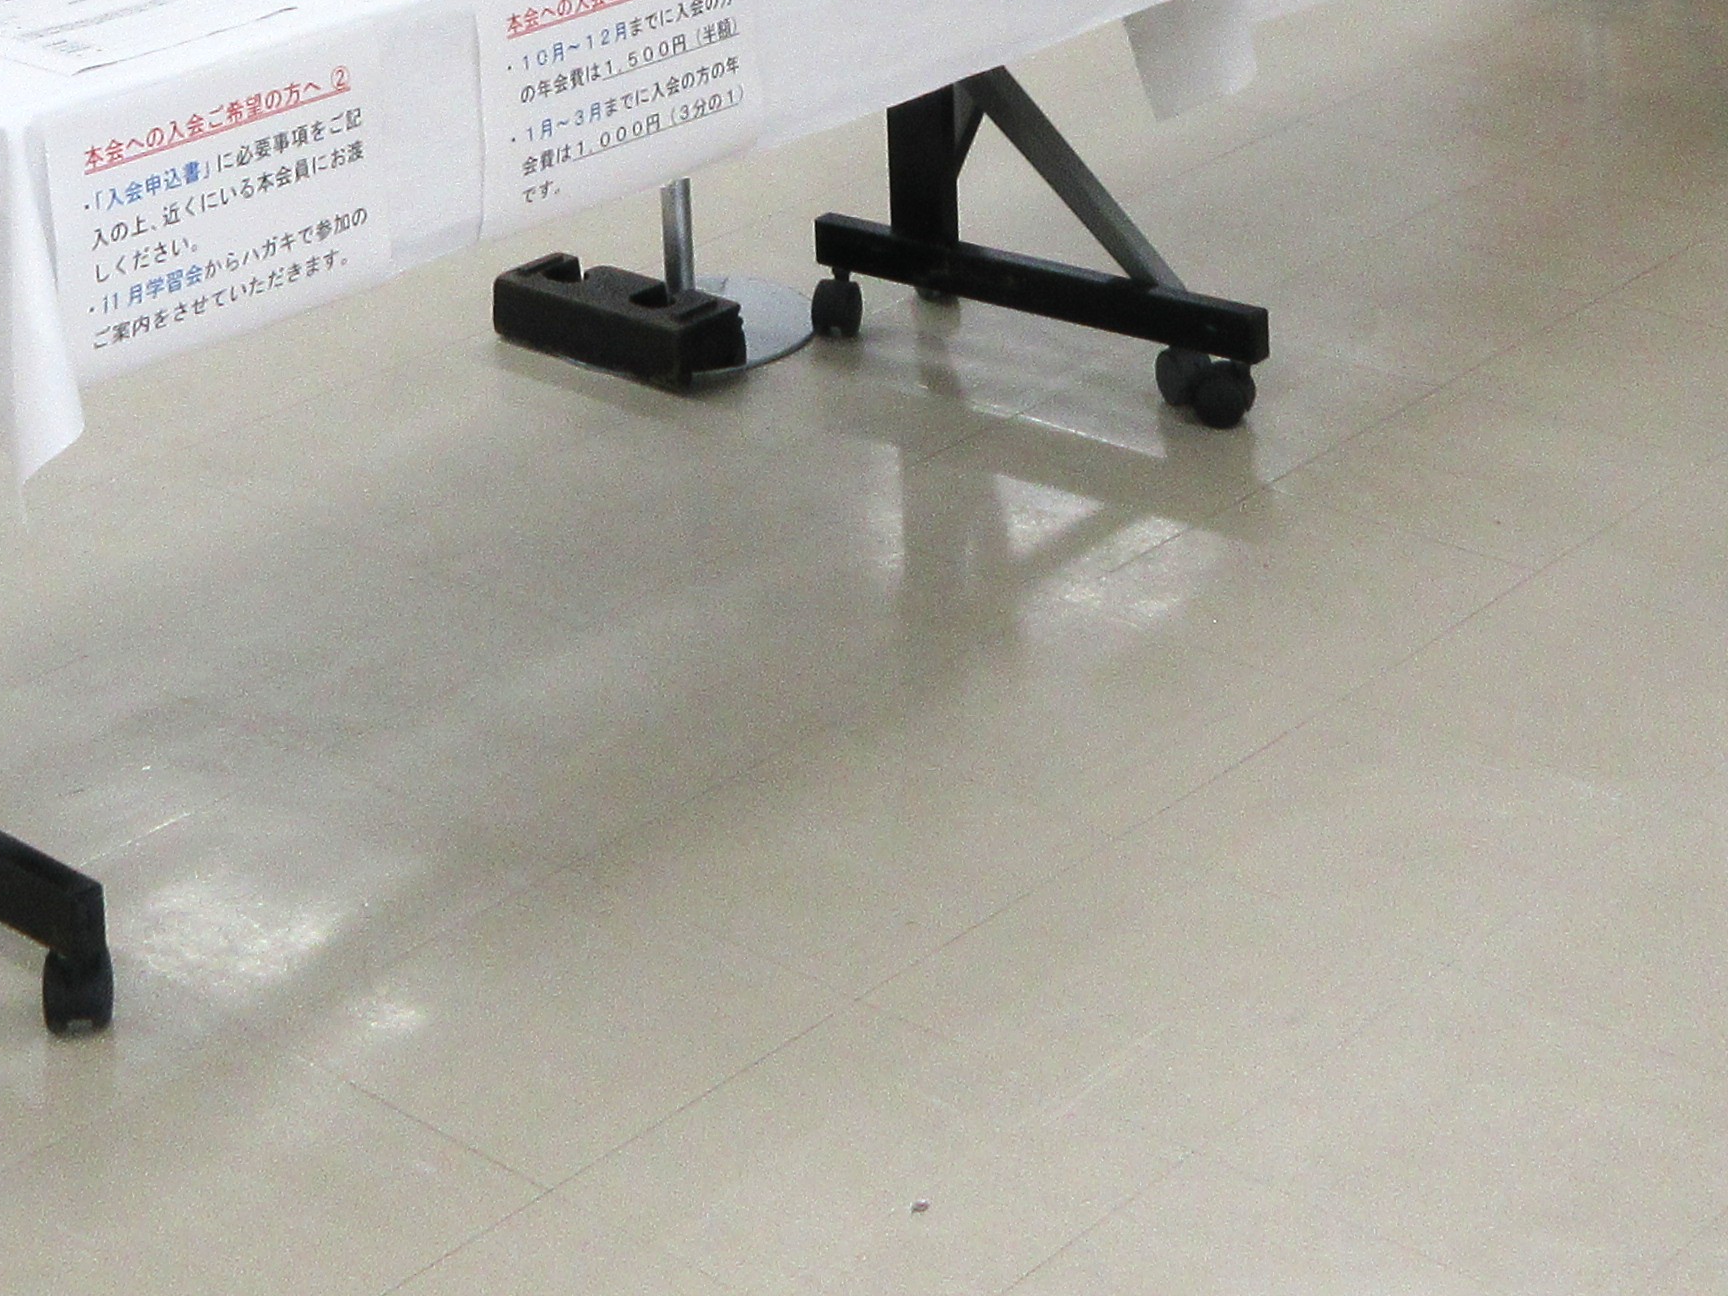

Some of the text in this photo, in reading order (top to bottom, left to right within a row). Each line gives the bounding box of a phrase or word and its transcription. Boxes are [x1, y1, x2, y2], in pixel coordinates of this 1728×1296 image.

[84, 82, 322, 171] 本会への入会ご希望の方へ
[91, 139, 366, 252] 入の上、近くにいる本会員にお渡
[522, 180, 562, 204] です。
[92, 249, 349, 351] ご案内をさせていただきます。
[95, 236, 199, 285] しください。
